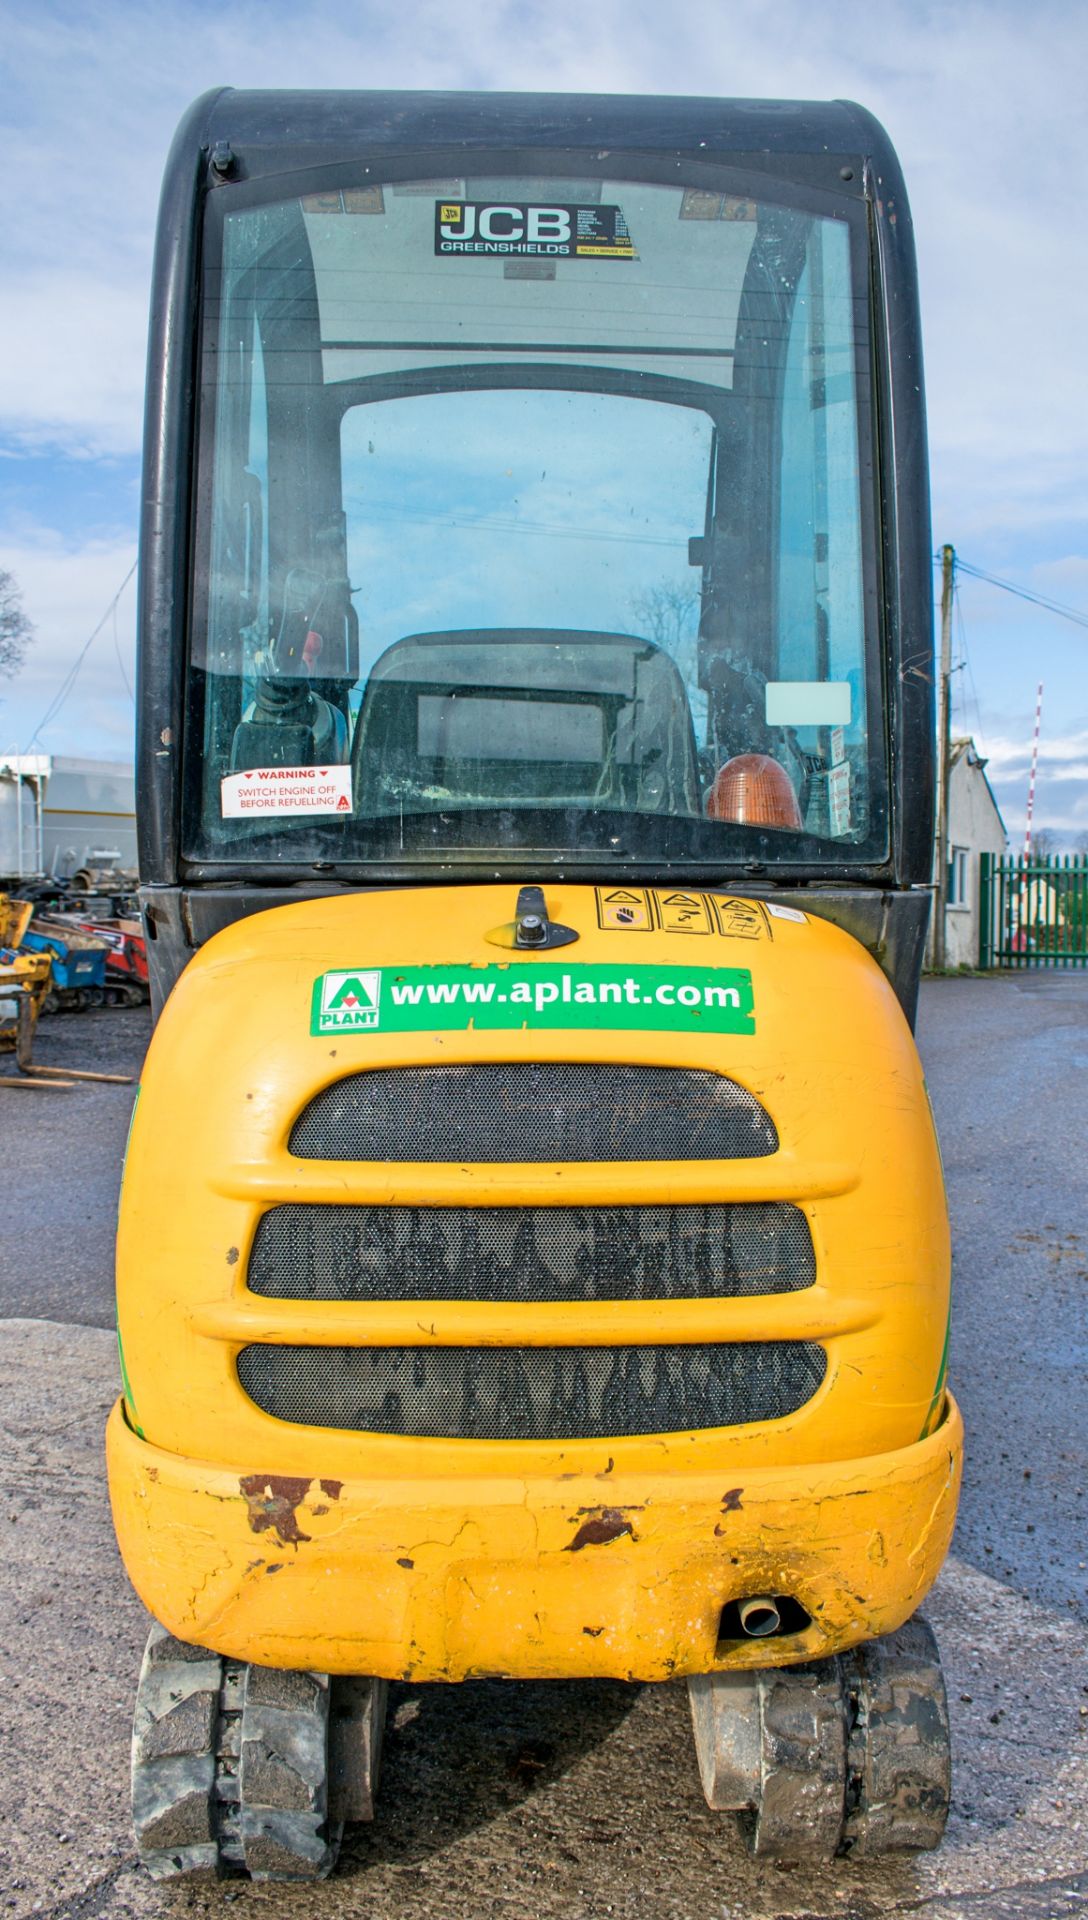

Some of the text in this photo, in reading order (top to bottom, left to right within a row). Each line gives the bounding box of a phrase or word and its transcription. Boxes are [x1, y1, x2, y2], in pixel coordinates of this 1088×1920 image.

[440, 206, 571, 242] JCB
[440, 242, 570, 254] GREENSHIELDS
[258, 770, 316, 780] WARNING
[238, 785, 336, 798] SWITCH ENGINE OFF
[240, 797, 335, 808] BEFORE REFUELLING
[328, 978, 373, 1009] A
[390, 975, 741, 1011] www.aplant.com
[320, 1012, 377, 1025] PLANT
